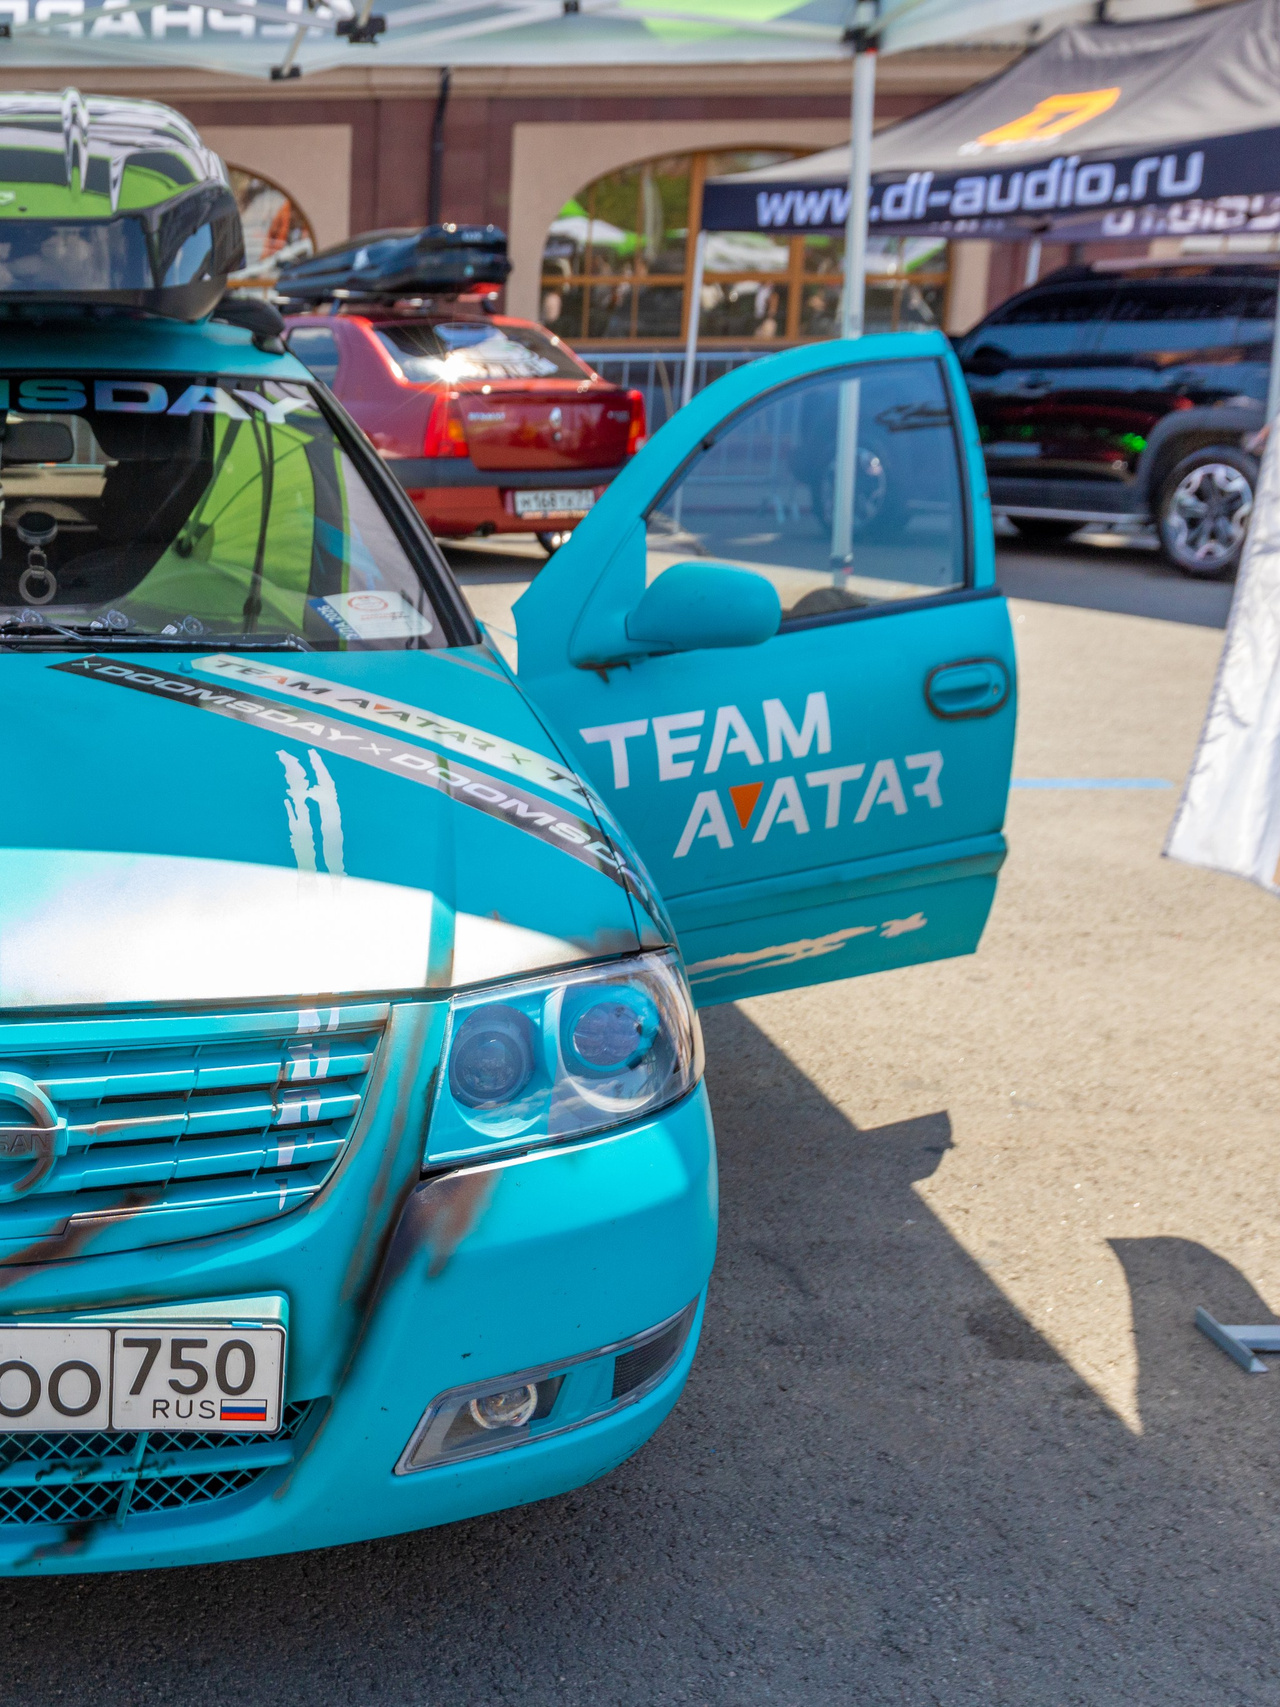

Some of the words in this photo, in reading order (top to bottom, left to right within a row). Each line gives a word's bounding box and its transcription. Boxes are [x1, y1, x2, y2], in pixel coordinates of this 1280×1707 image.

[94, 666, 363, 742] DOOMSDAY
[215, 659, 332, 695] TEAM
[339, 697, 497, 753] AVATAR
[579, 691, 832, 790] TEAM
[673, 750, 944, 859] AVATAR
[122, 1338, 256, 1396] 750
[153, 1399, 216, 1419] RUS
